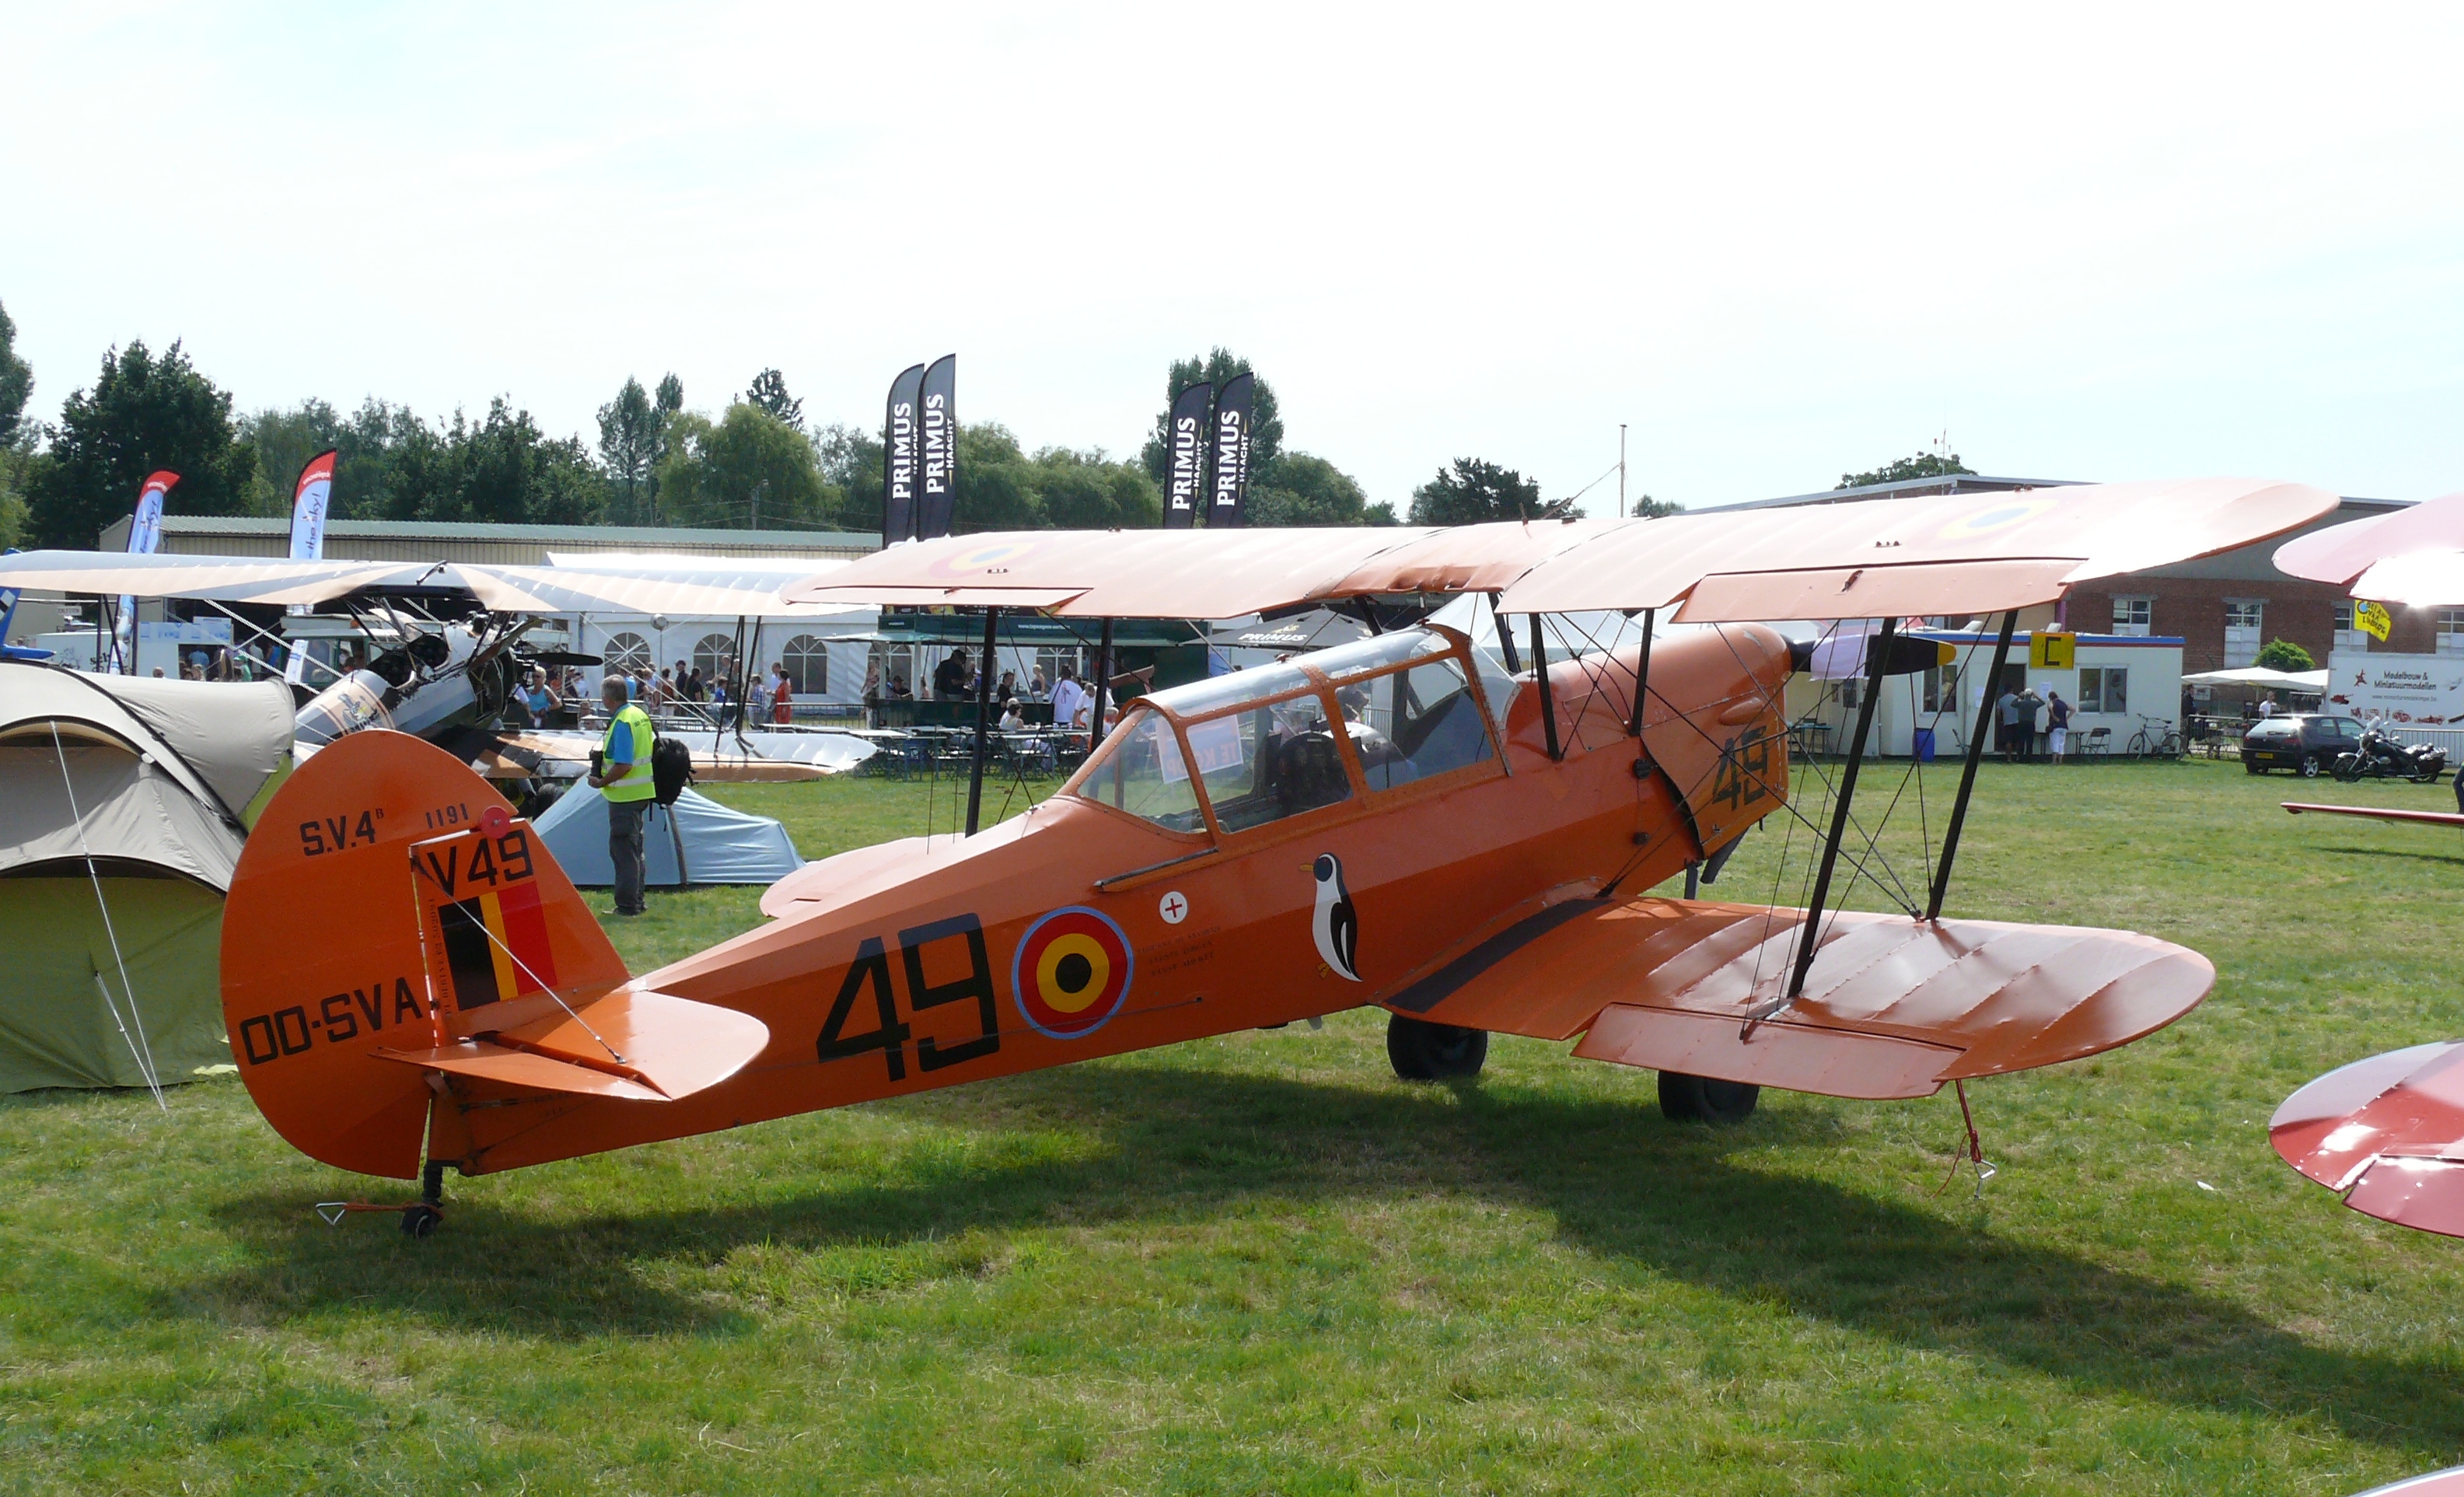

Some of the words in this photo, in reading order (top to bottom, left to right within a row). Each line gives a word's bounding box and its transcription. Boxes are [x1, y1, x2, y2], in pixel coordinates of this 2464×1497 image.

[893, 402, 911, 499] PRIMUS
[926, 393, 944, 494] PRIMUS
[1172, 417, 1196, 510] PRIMUS
[1193, 441, 1203, 488] HAACHT
[1217, 411, 1239, 506] PRIMUS
[1239, 435, 1249, 482] HAACHT
[1238, 633, 1307, 642] PRIMUS
[2044, 637, 2061, 666] C
[2374, 680, 2437, 691] Miniatuurmodellen
[2383, 670, 2421, 680] Modelbouw
[2423, 672, 2427, 680] &
[1711, 725, 1768, 810] 49
[426, 803, 469, 830] 1191
[239, 977, 424, 1066] OO-SVA
[816, 912, 1001, 1083] 49
